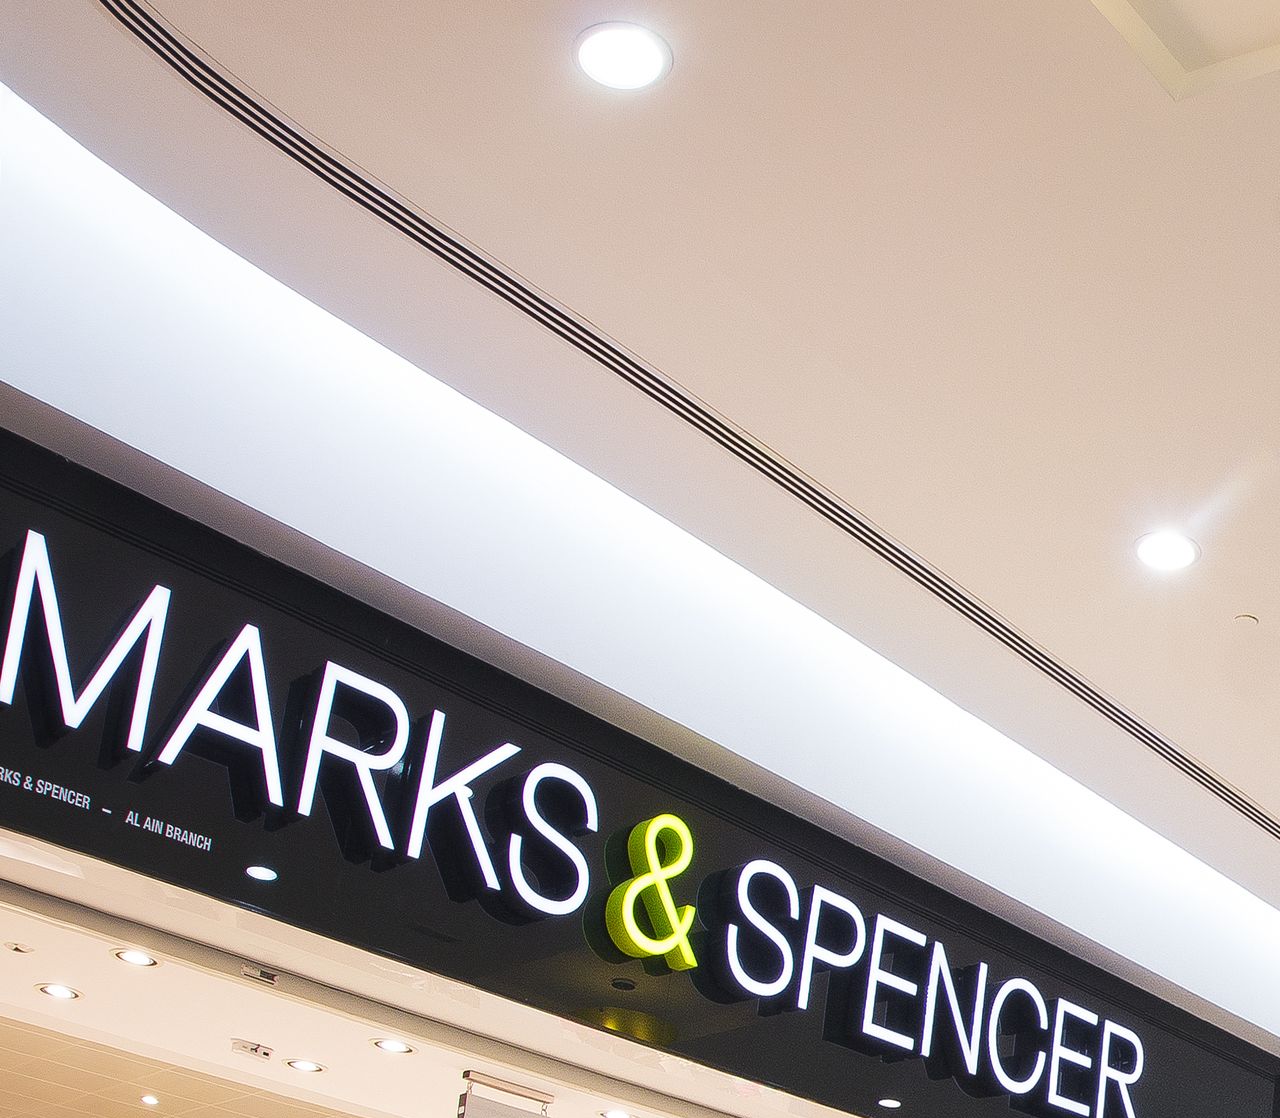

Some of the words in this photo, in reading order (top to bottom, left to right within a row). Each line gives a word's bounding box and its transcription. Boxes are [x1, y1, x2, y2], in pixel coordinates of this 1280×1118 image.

[0, 530, 599, 915] MARKS
[606, 813, 698, 970] &
[0, 767, 21, 787] RKS
[23, 776, 33, 791] &
[36, 779, 91, 810] SPENCER
[125, 811, 141, 828] AL
[143, 817, 164, 835] AIN
[165, 824, 212, 852] BRANCH
